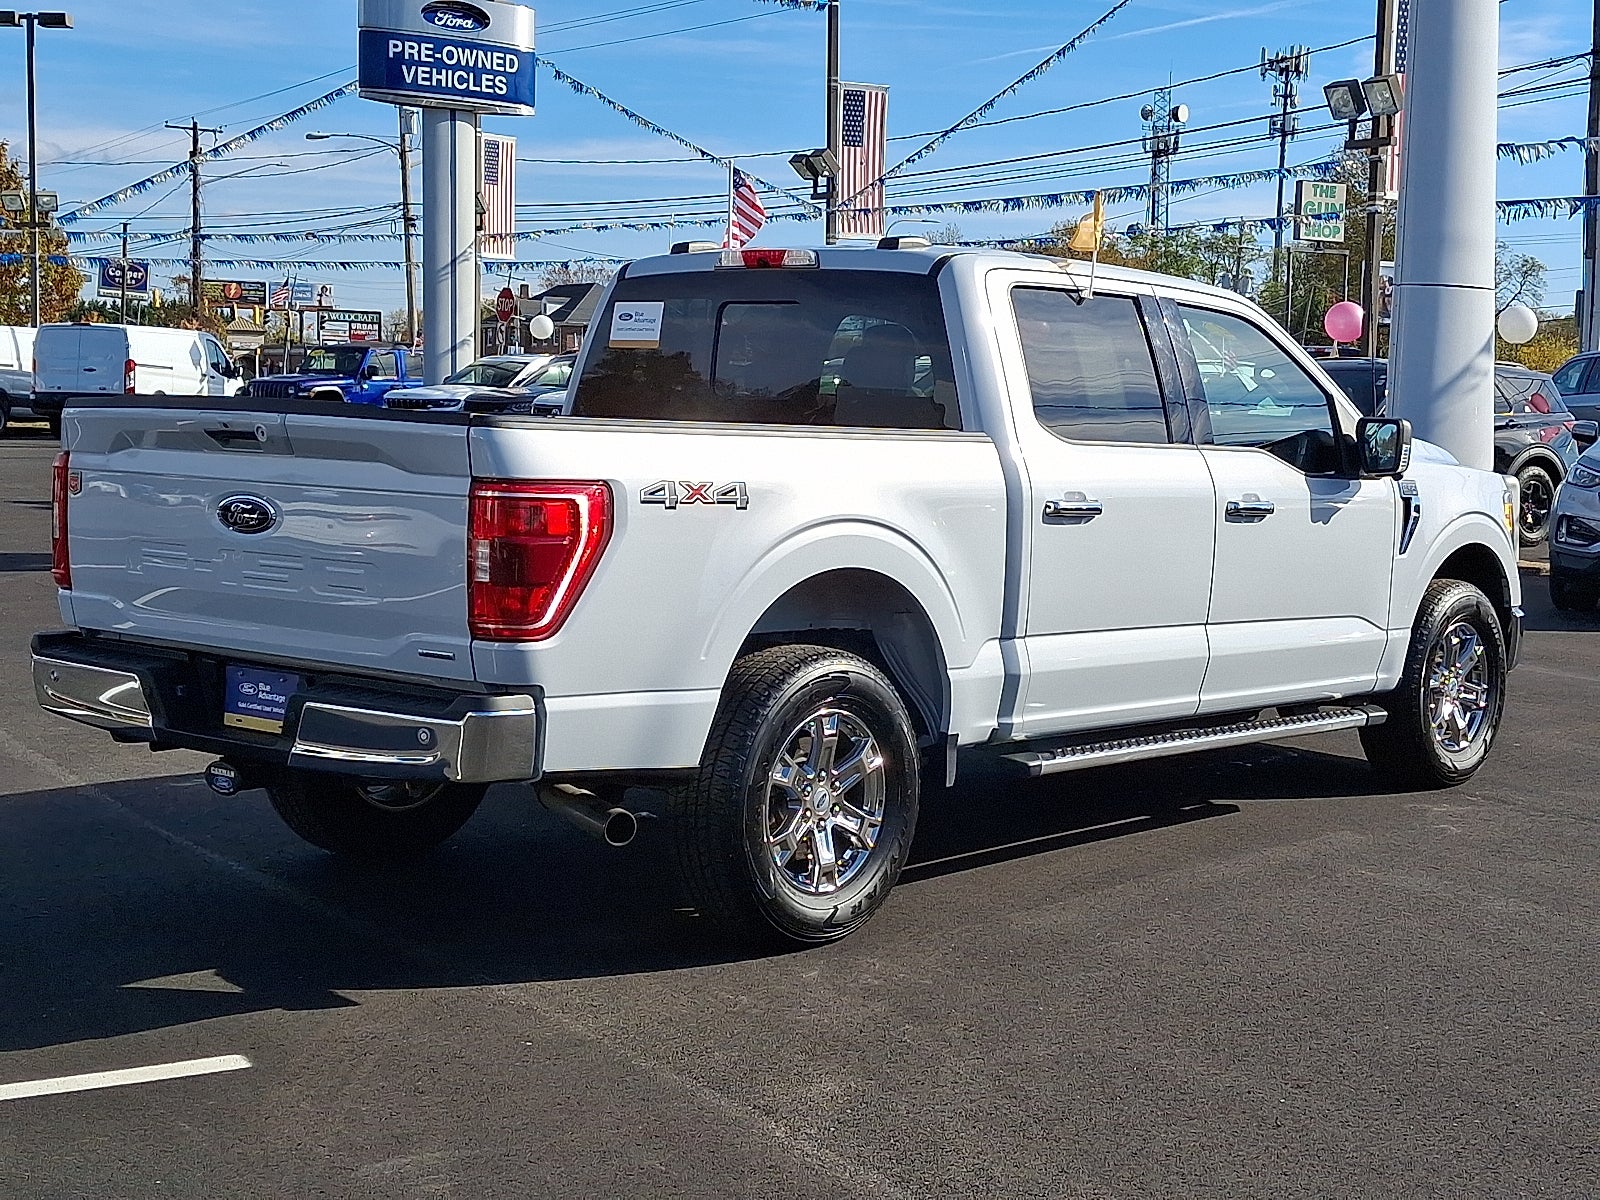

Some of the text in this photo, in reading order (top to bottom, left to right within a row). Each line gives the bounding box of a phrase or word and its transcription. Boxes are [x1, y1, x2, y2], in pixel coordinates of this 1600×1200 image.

[434, 10, 475, 30] Ford
[388, 40, 519, 73] PRE-OWNED
[401, 65, 508, 95] VEHICLES
[1312, 184, 1337, 198] THE
[1304, 225, 1341, 238] SHOP
[108, 267, 143, 279] Coper
[498, 298, 513, 312] STOP
[330, 312, 379, 322] WOODCRAFT
[351, 323, 379, 331] URBAN
[227, 502, 260, 526] Ford
[258, 682, 272, 692] Blue
[257, 691, 286, 704] Advantage
